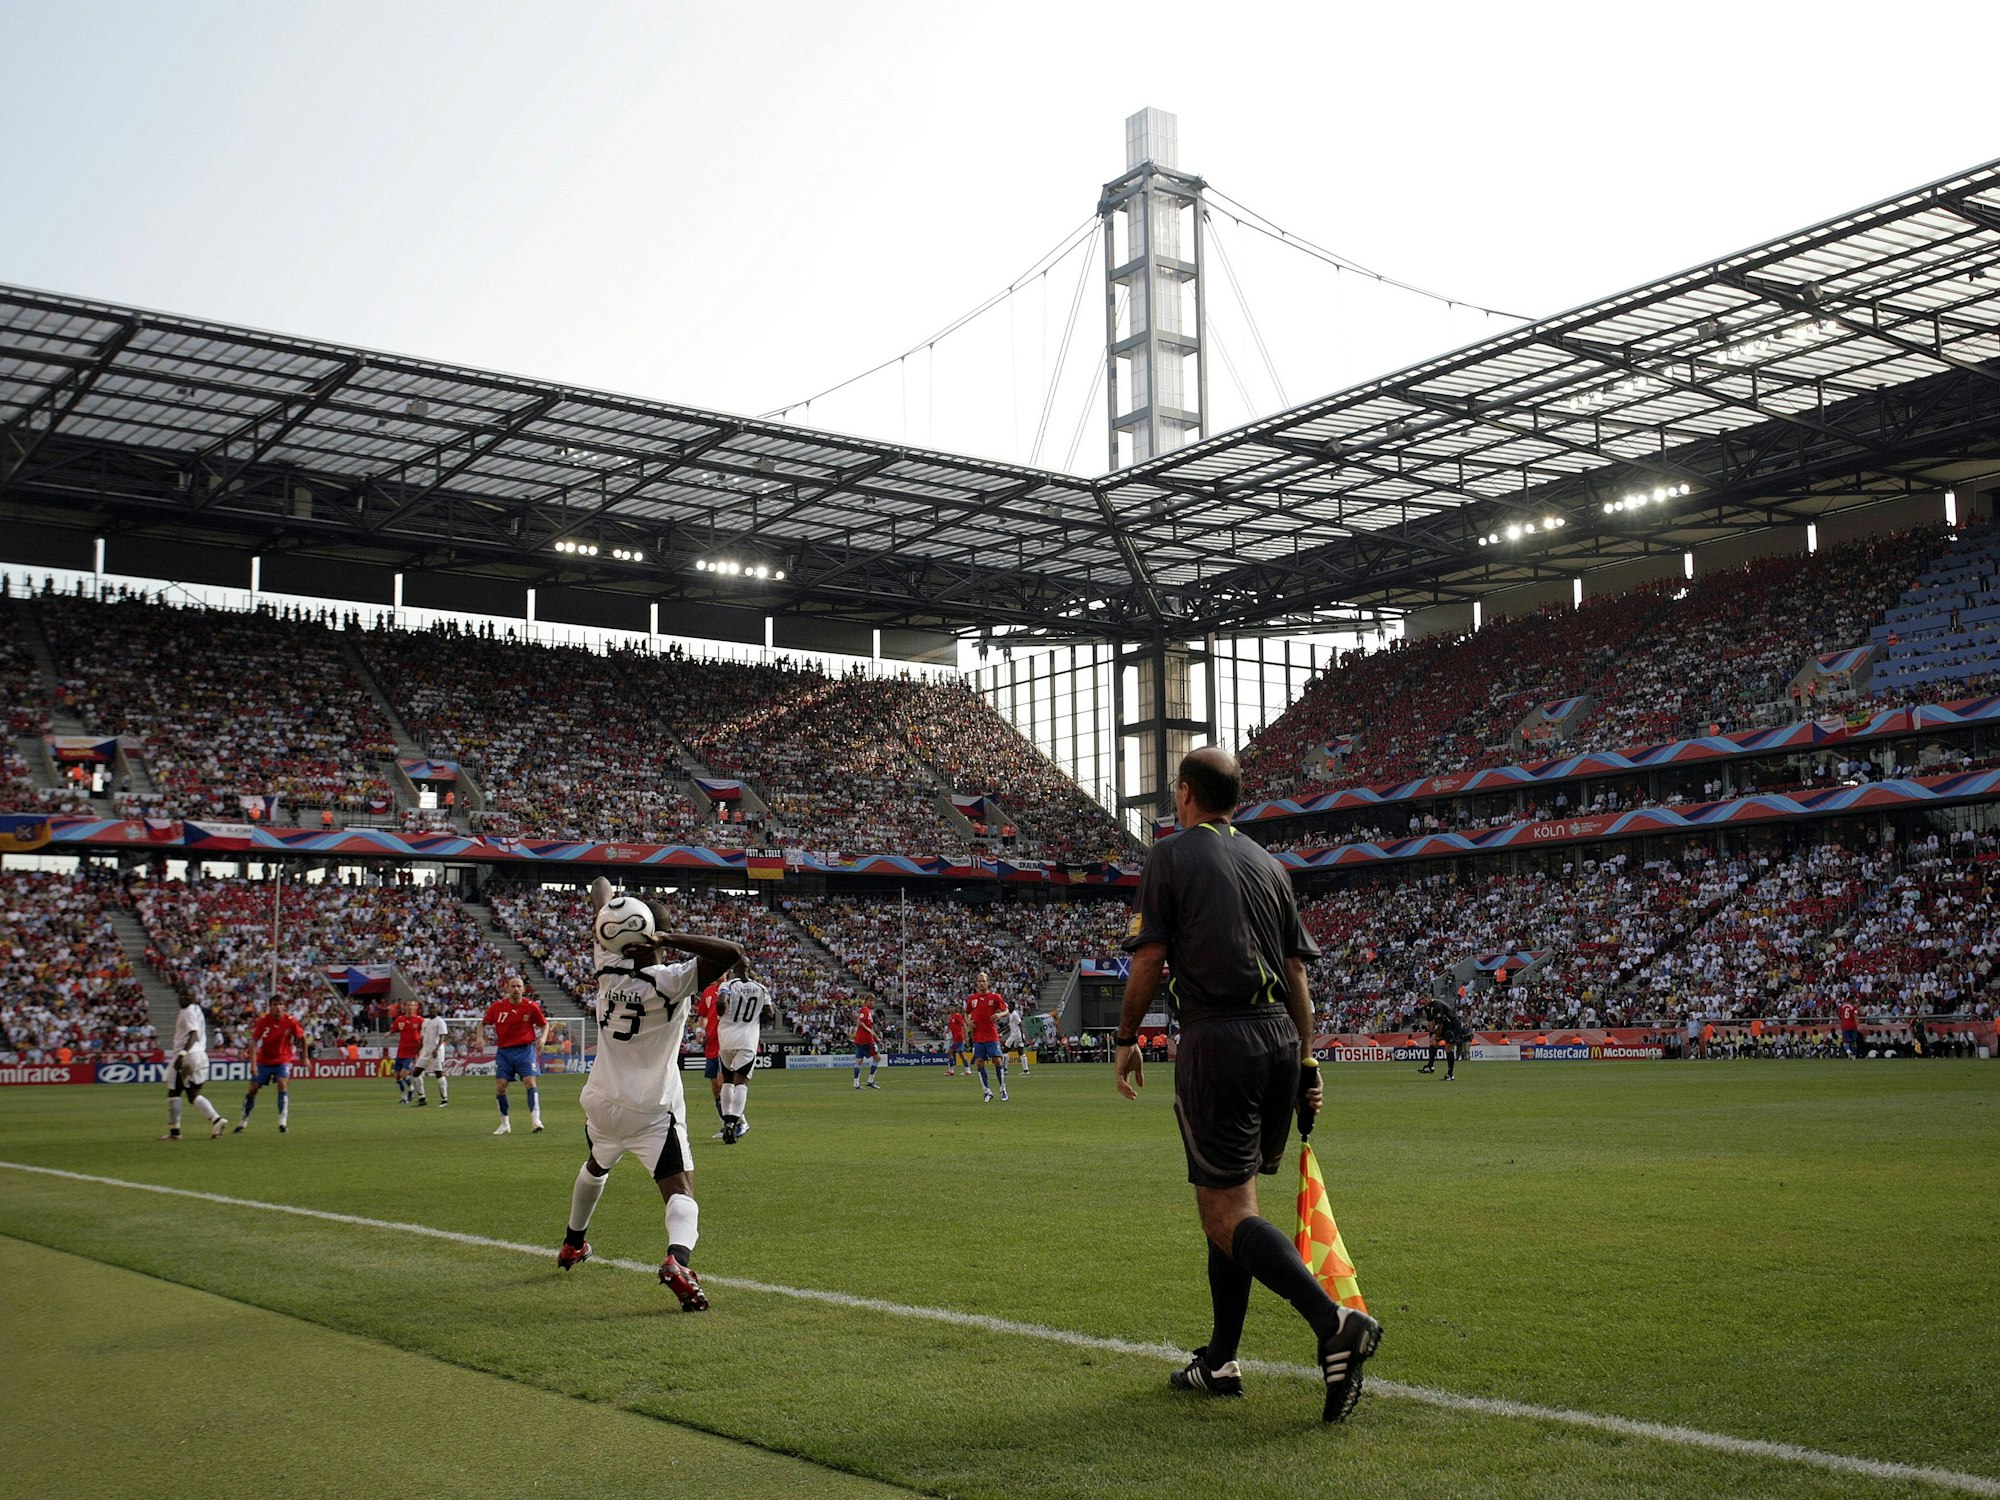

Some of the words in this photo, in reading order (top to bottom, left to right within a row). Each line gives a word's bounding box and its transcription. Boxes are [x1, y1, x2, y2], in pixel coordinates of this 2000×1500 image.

[733, 996, 758, 1022] 10
[497, 1011, 509, 1023] 17
[262, 1027, 270, 1037] 2
[1535, 1048, 1589, 1059] MasterCard
[921, 1055, 932, 1065] for
[138, 1063, 253, 1082] HYDAI
[315, 1062, 360, 1077] lovin'
[365, 1061, 376, 1076] it
